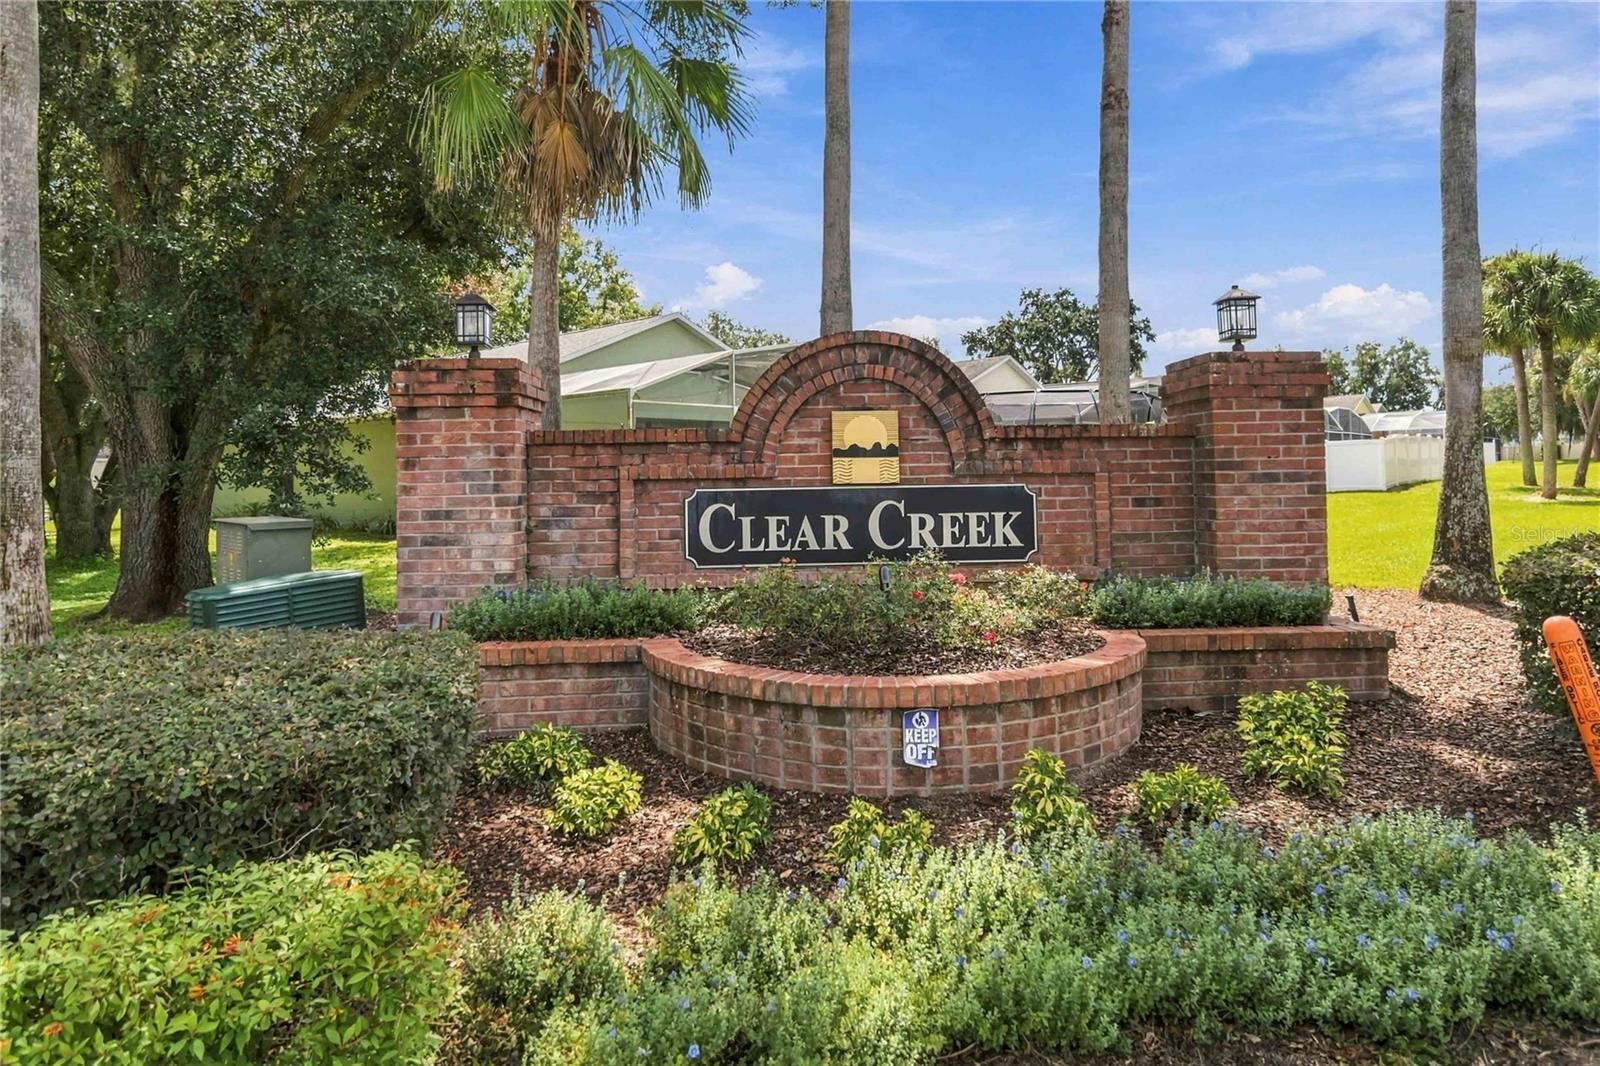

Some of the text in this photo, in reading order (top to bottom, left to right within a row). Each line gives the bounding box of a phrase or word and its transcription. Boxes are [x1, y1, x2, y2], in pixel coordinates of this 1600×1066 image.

[699, 500, 1025, 553] CLEAR CREEK
[1566, 685, 1586, 725] OPTIC
[905, 728, 938, 744] KEEP
